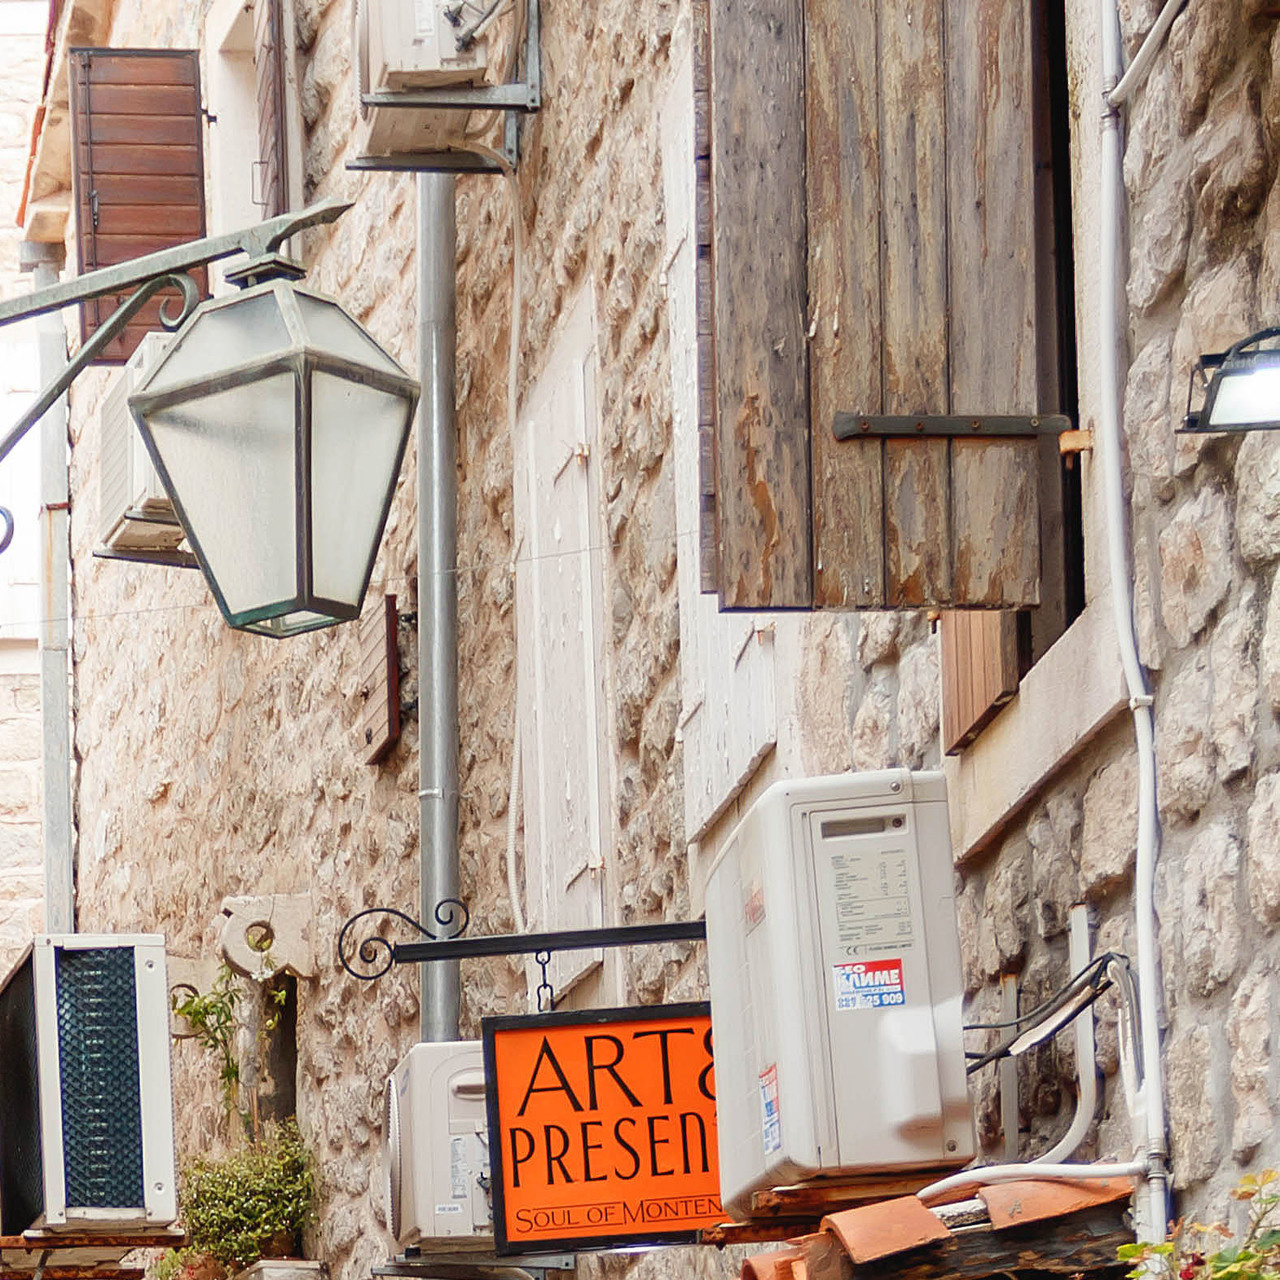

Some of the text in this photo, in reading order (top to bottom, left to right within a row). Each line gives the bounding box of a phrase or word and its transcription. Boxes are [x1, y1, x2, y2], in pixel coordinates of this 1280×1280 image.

[862, 995, 880, 1006] 25
[509, 1110, 717, 1188] PRESEN
[516, 1198, 723, 1233] SOUL OF MONTEN
